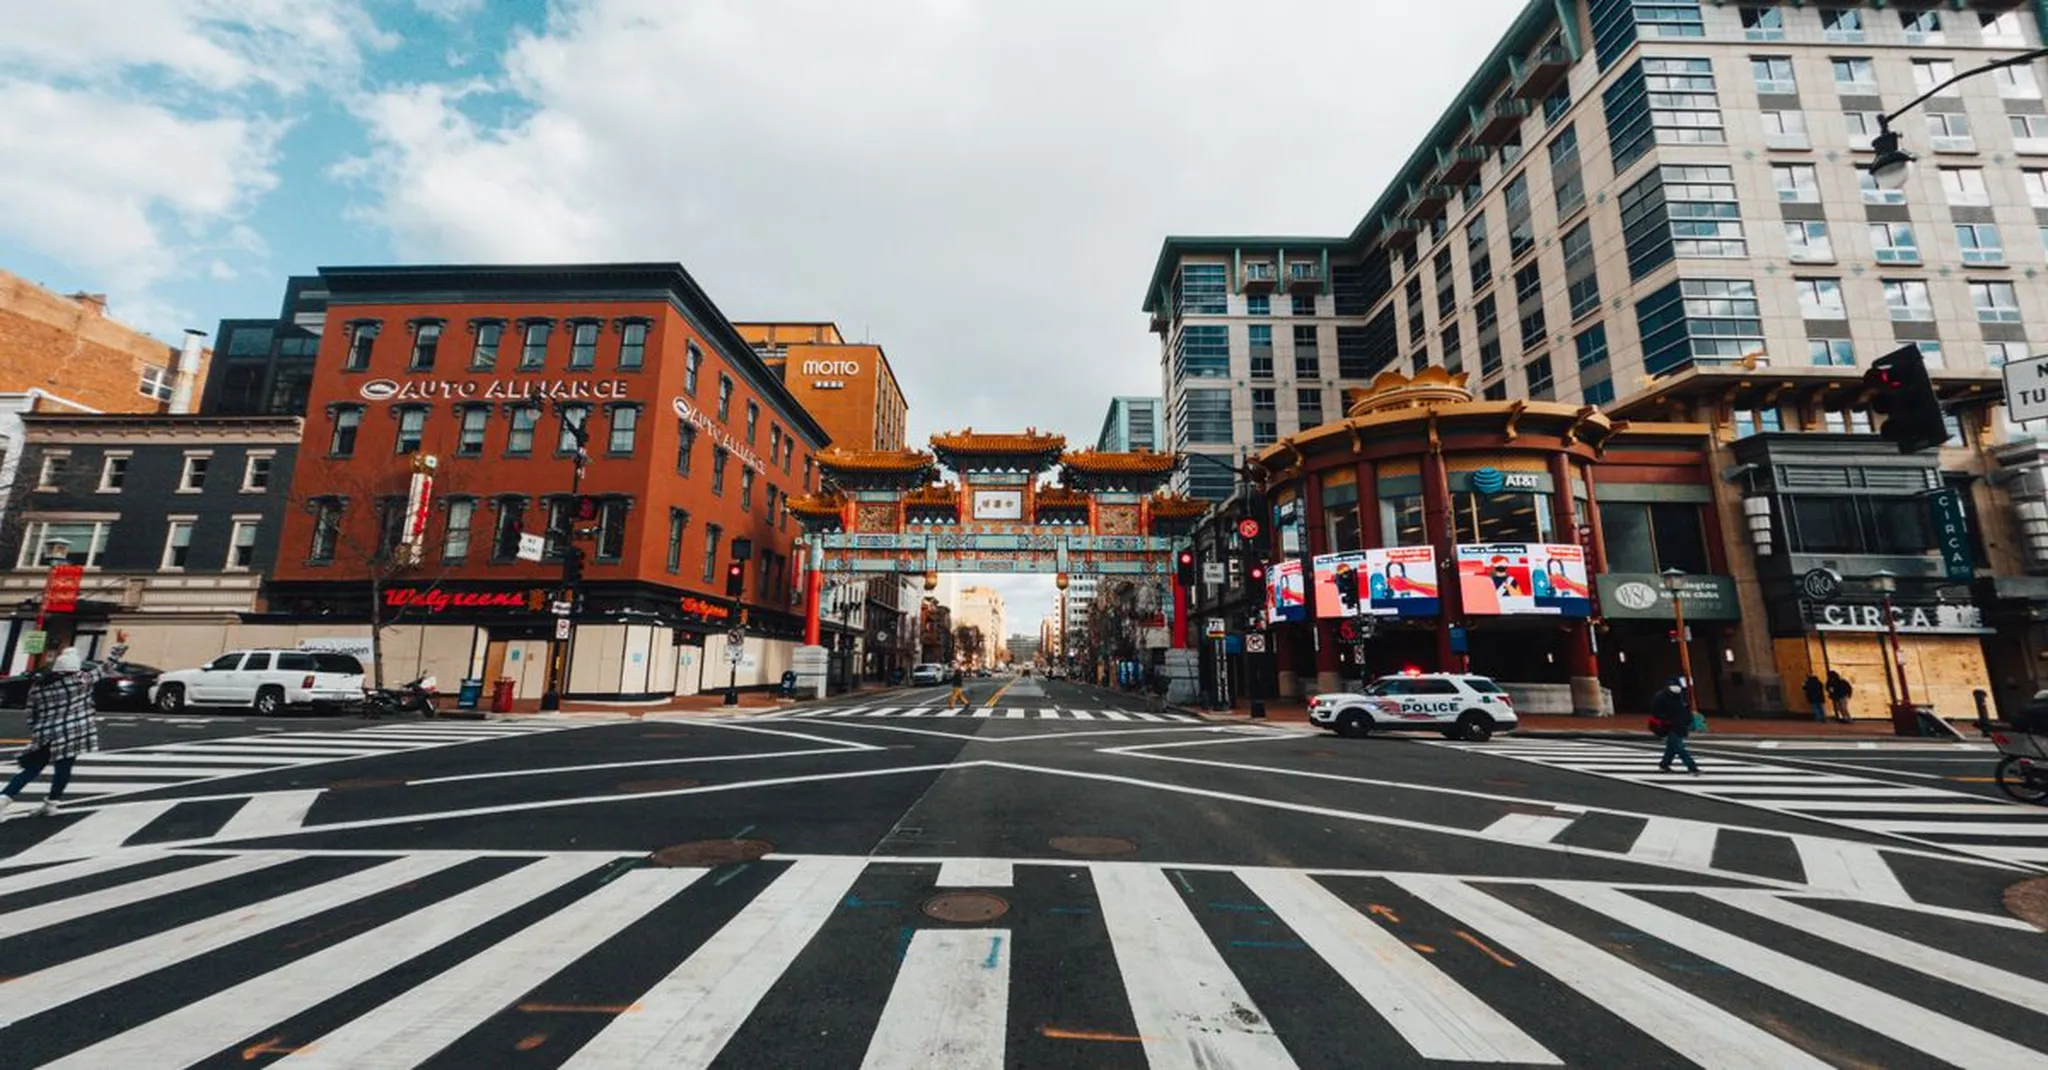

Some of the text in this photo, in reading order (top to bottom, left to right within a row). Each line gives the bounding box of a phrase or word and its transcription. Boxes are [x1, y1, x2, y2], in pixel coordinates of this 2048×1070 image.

[802, 360, 861, 375] MOTTO
[397, 380, 628, 399] AUTO ALLIANCE
[2018, 388, 2047, 406] TU
[1504, 474, 1538, 488] AT&T
[1938, 496, 1964, 562] CIRCA
[385, 588, 525, 612] Walgreens
[1823, 604, 1932, 628] CIRCA
[1402, 702, 1460, 713] POLICE
